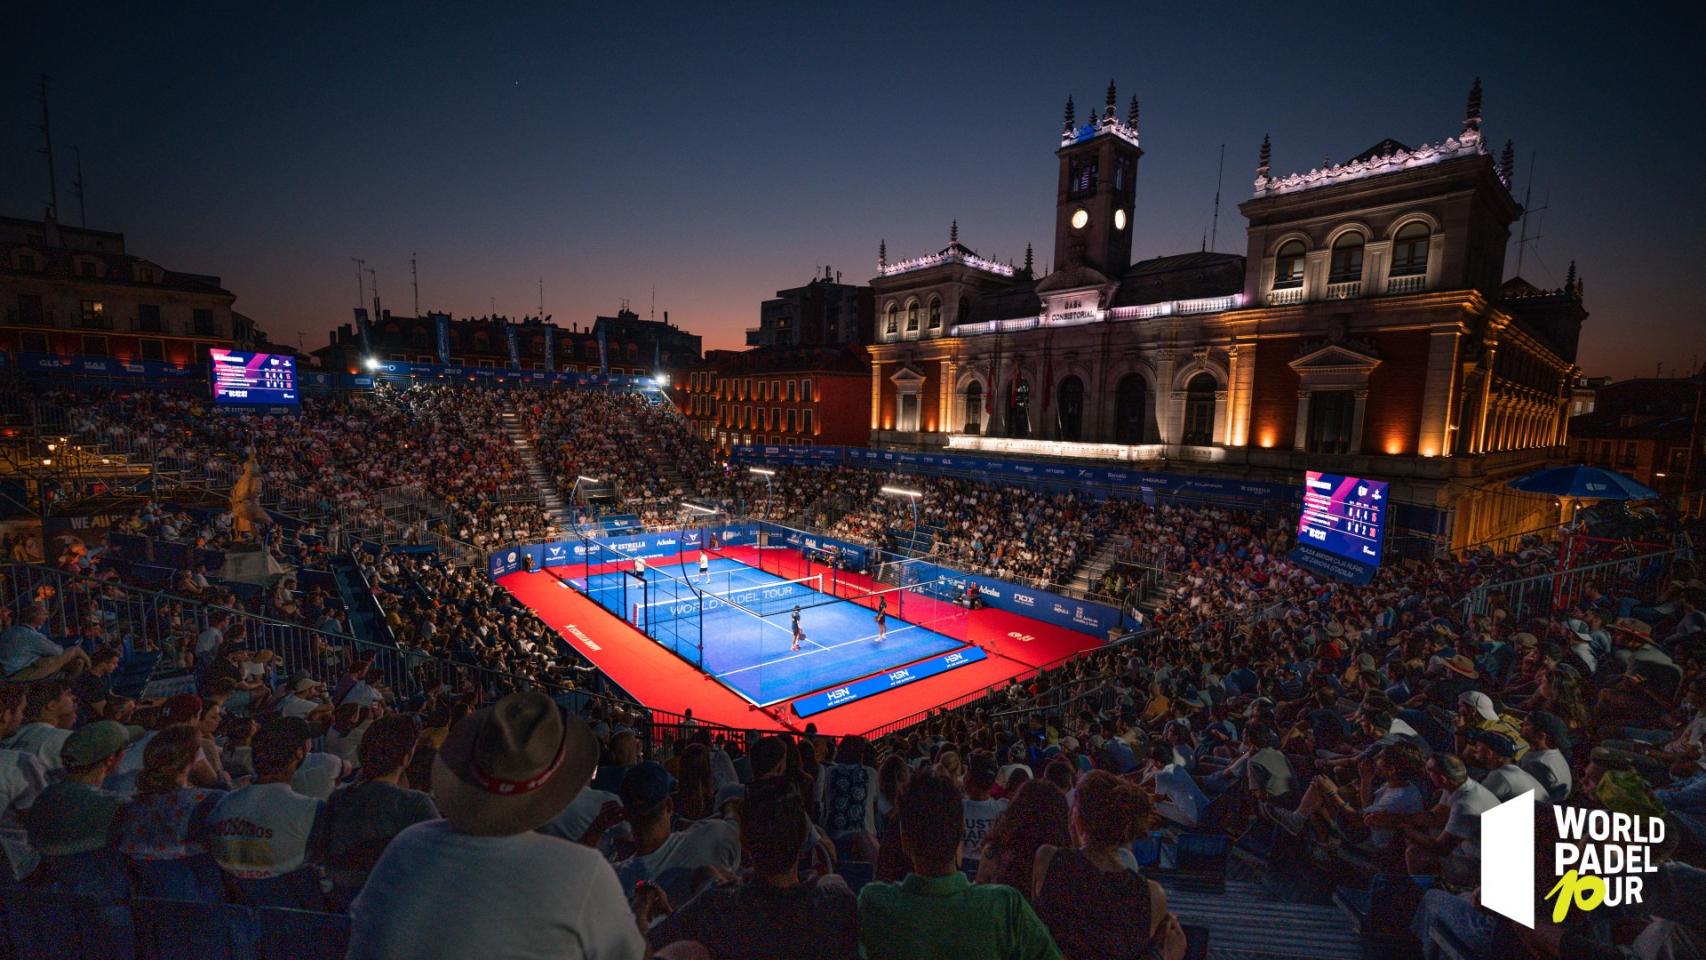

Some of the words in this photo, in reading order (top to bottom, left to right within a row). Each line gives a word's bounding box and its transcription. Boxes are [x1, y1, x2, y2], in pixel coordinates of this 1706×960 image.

[1052, 311, 1095, 321] CONSISTORIAL
[669, 599, 718, 615] WORLD
[763, 586, 793, 599] TOUR
[889, 669, 909, 680] HSN
[827, 687, 849, 700] HSN
